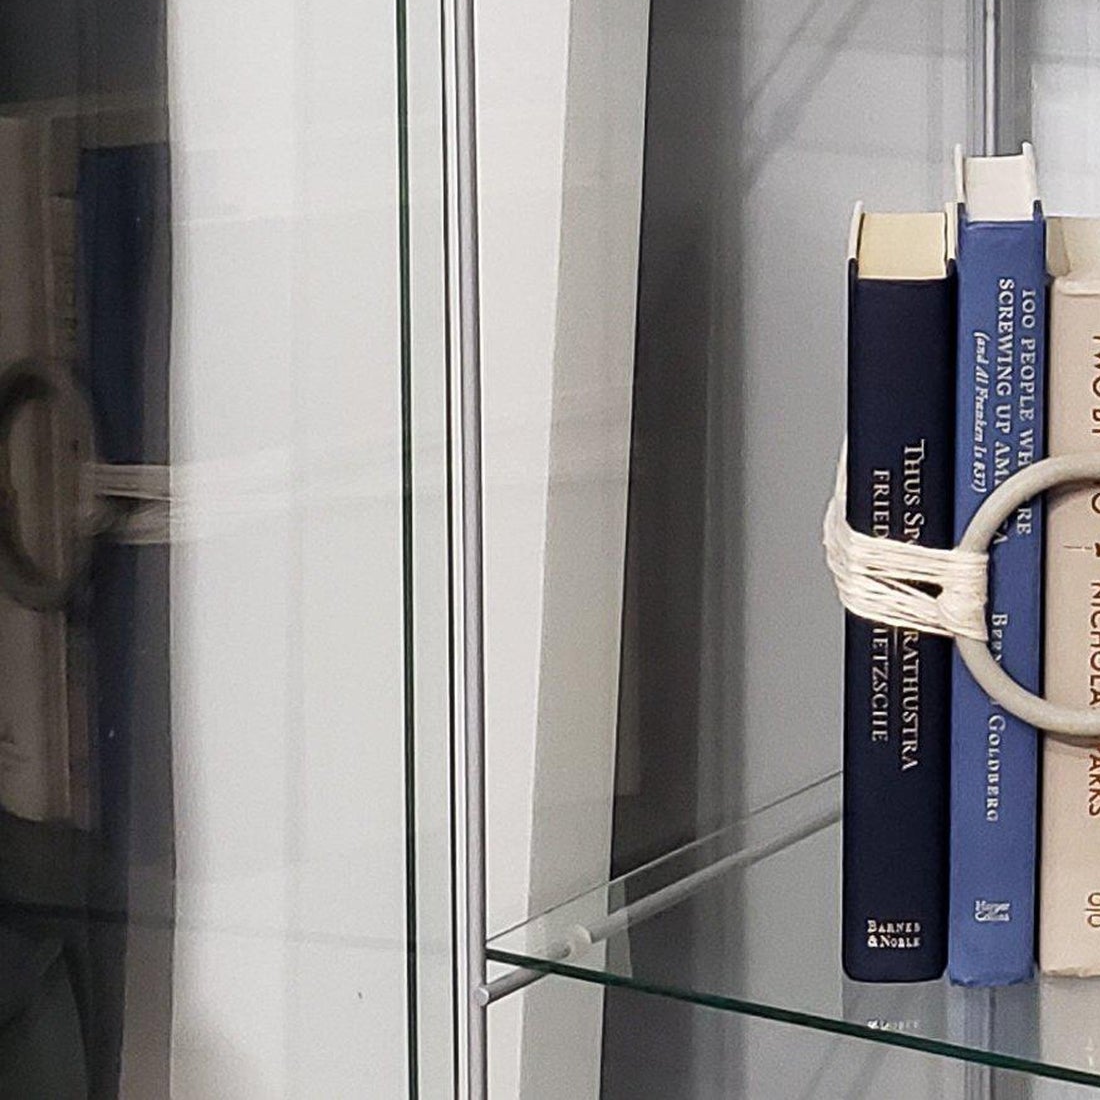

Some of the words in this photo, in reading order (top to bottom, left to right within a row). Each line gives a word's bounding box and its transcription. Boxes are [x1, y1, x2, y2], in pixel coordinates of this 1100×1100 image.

[995, 278, 1015, 398] SCREWING
[1019, 338, 1036, 422] PEOPLE
[995, 405, 1013, 433] UP
[1017, 429, 1034, 468] WH
[872, 470, 891, 539] FRIED
[1016, 505, 1033, 535] RE
[871, 628, 889, 743] IETZSCHE
[902, 629, 920, 772] RATHUSTRA
